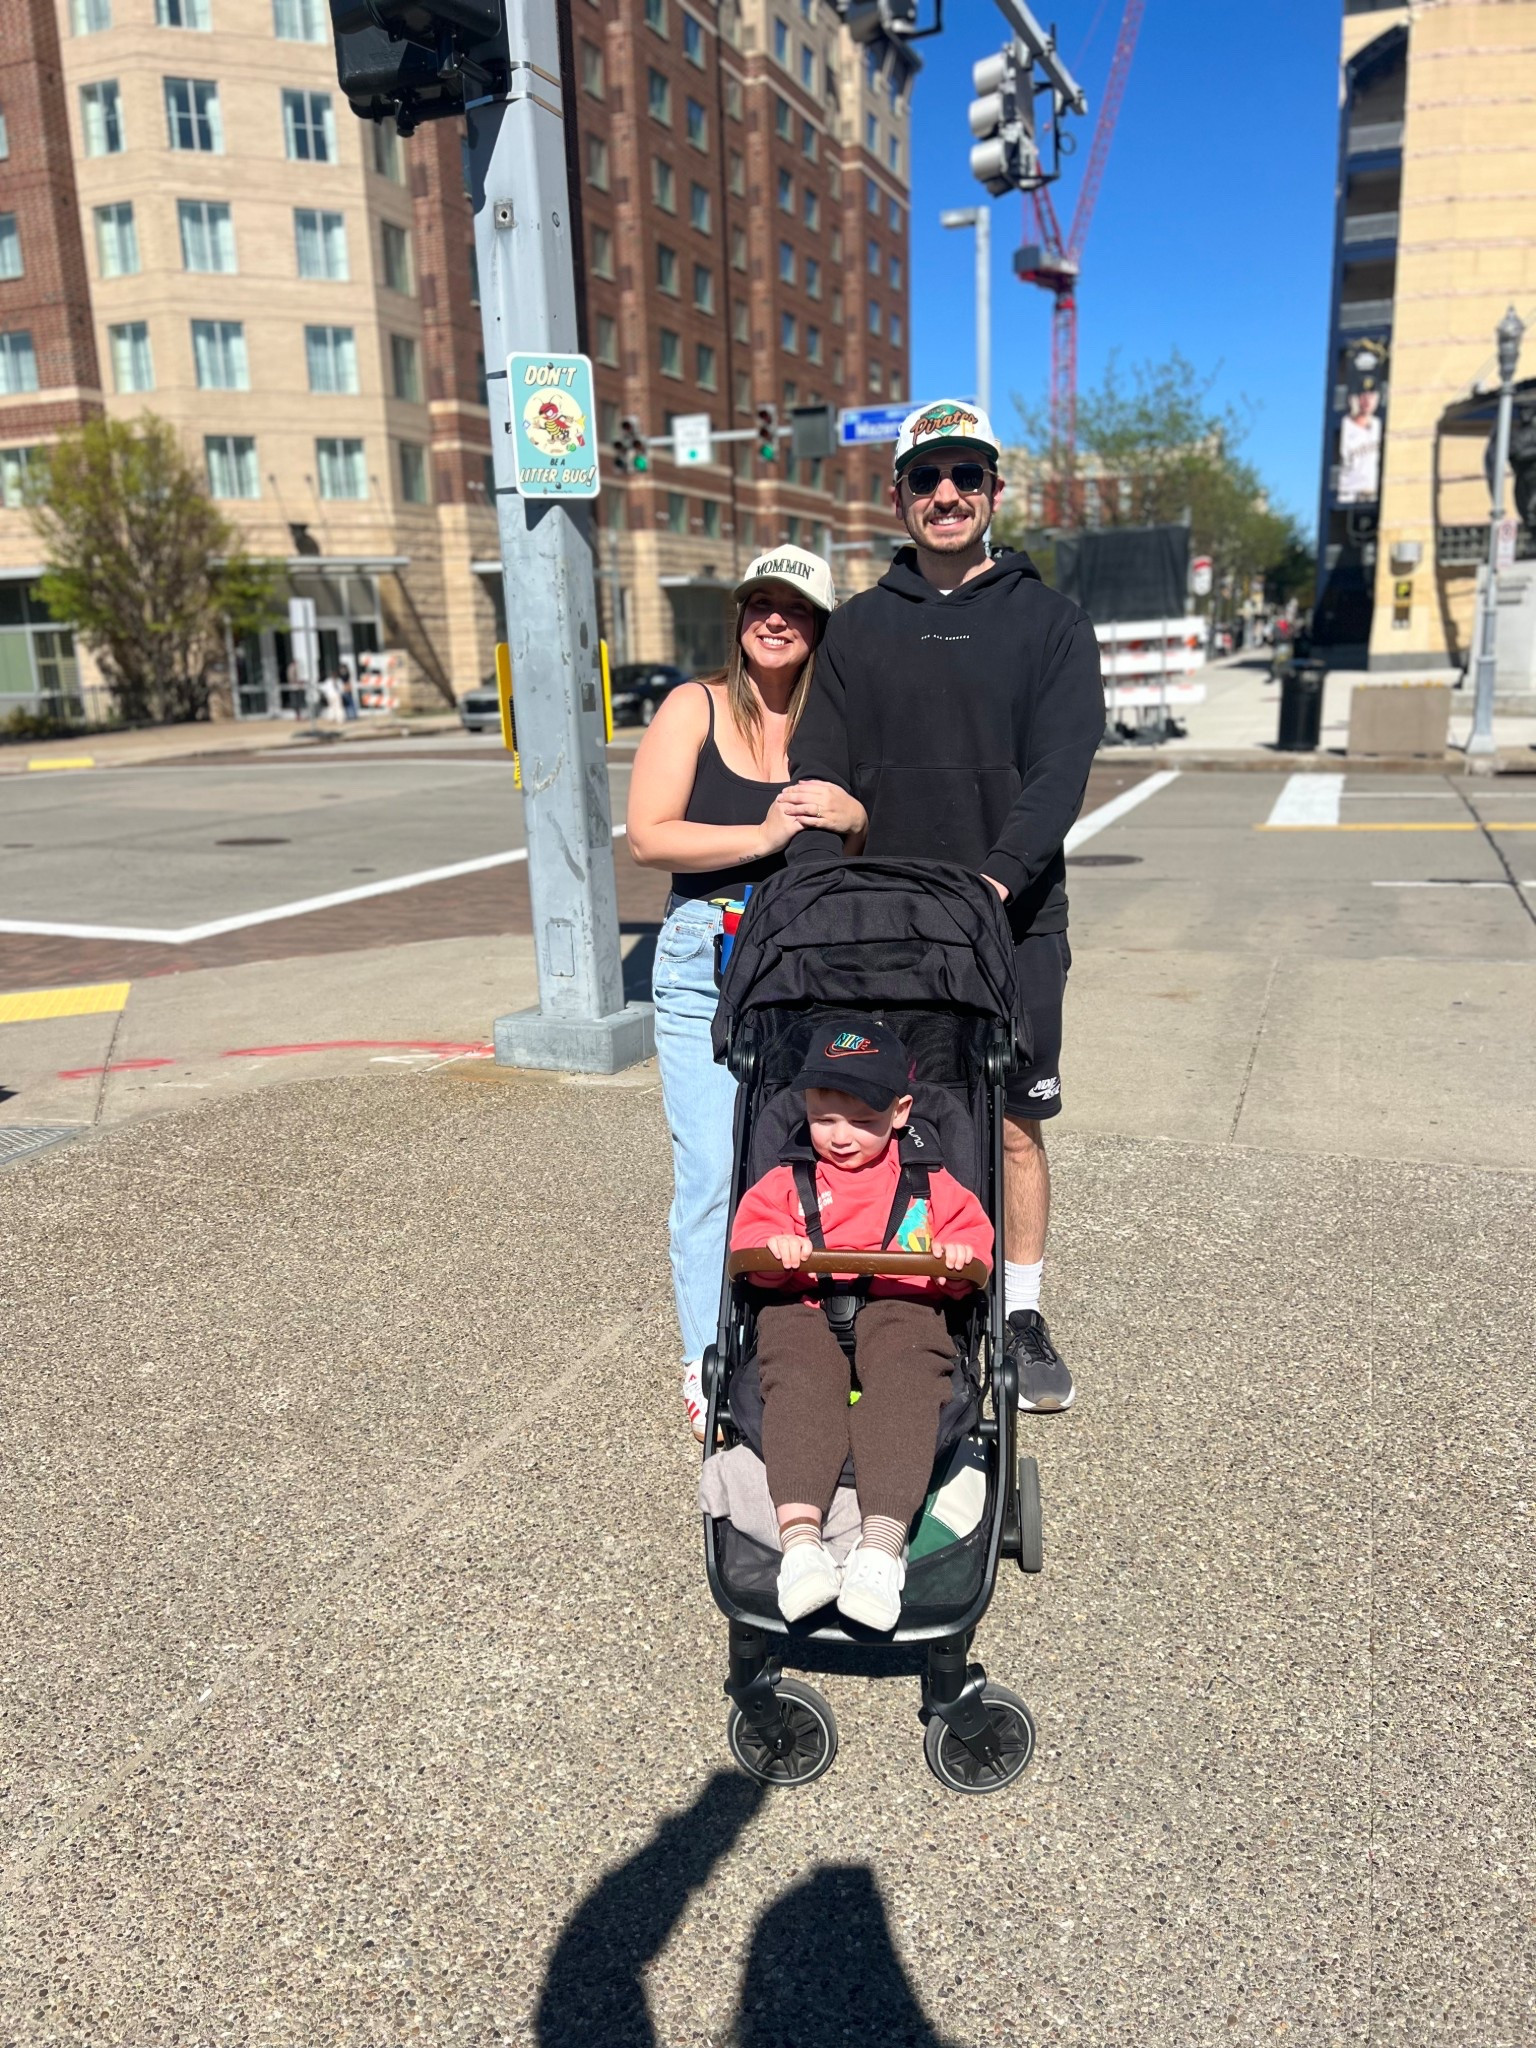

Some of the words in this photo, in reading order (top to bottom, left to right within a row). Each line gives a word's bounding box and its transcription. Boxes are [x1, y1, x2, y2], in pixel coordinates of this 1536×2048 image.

[524, 365, 577, 387] DON'T
[910, 411, 978, 446] Pirates
[519, 468, 558, 483] LITTER
[562, 466, 596, 487] BUG!
[755, 558, 815, 580] MOMMIN'
[833, 1032, 872, 1051] NIKE
